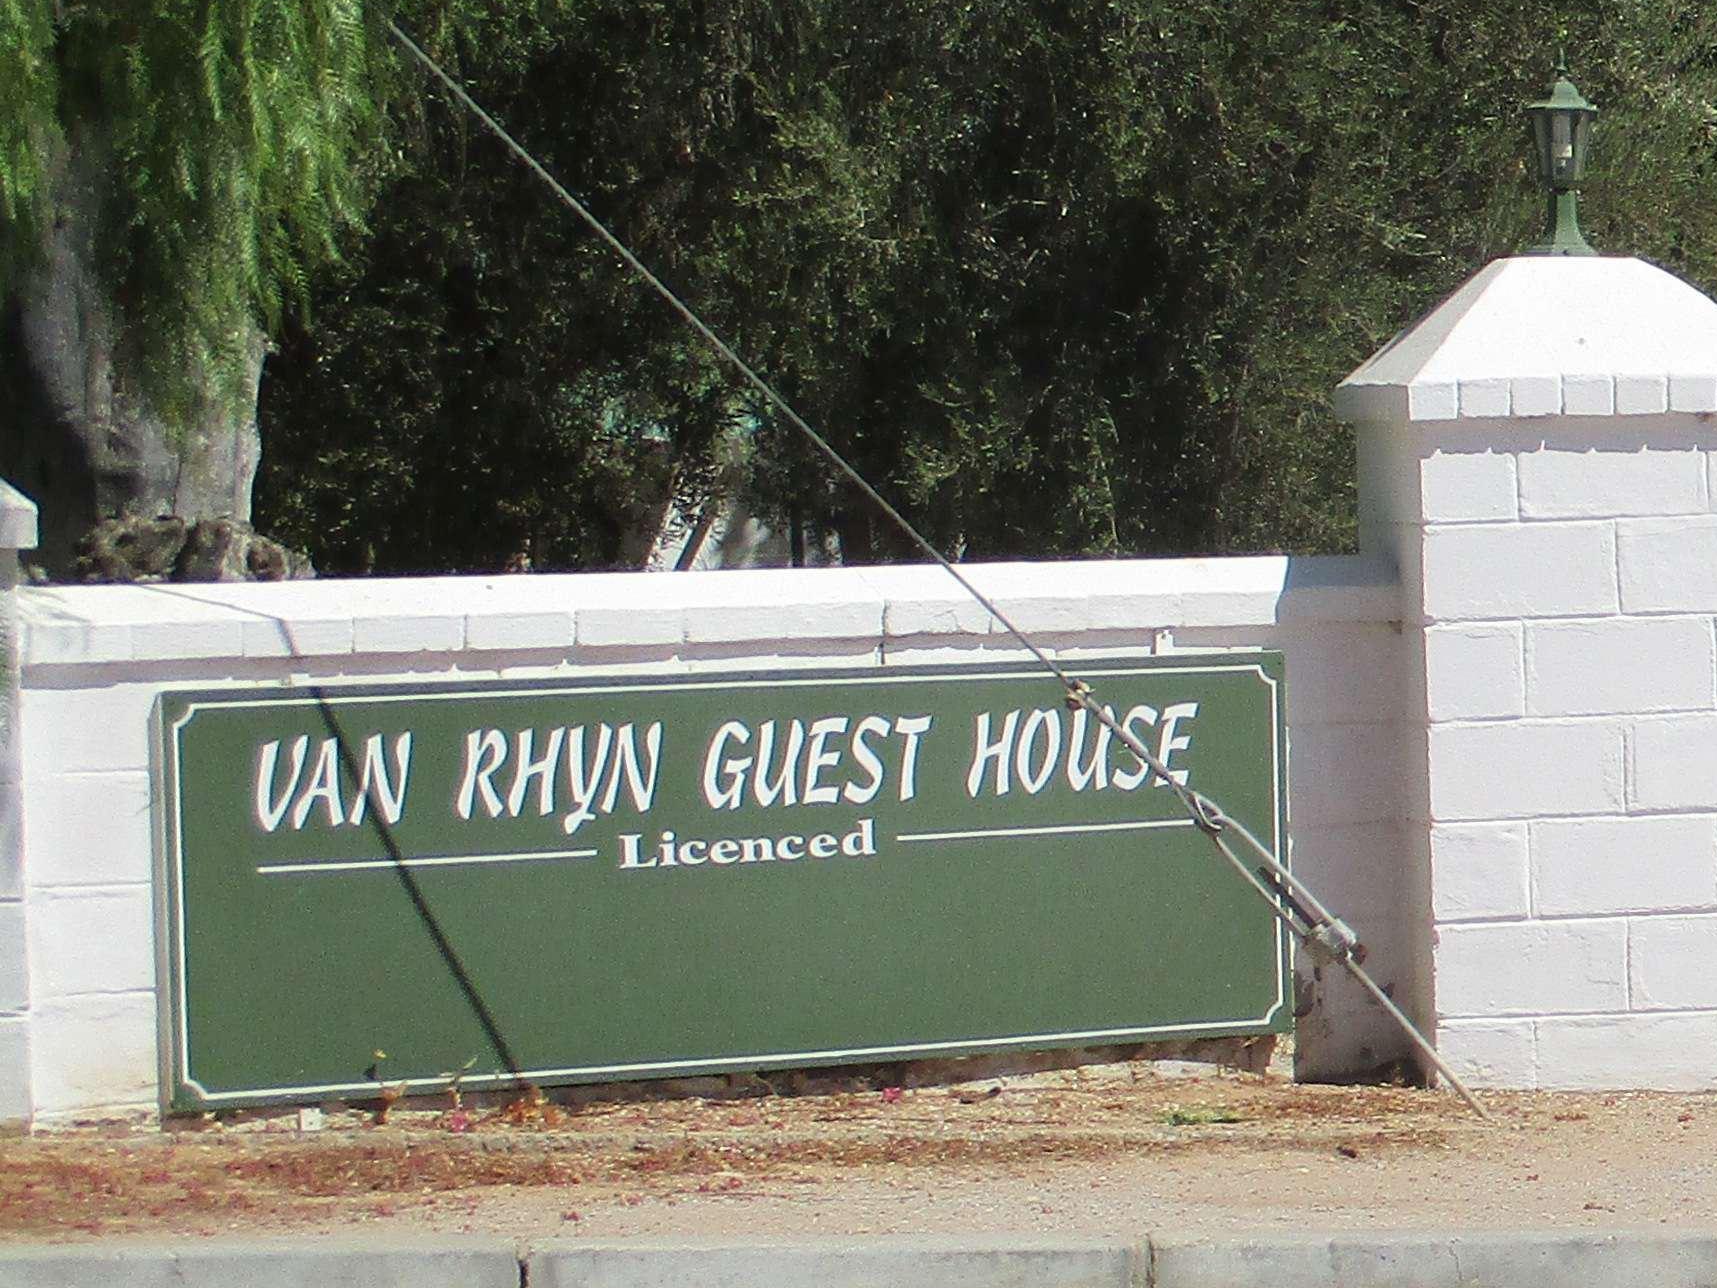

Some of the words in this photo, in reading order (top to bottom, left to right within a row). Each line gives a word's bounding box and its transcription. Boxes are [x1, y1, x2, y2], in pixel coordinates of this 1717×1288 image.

[255, 731, 413, 833] VAN
[456, 720, 662, 831] RHYN
[703, 715, 933, 811] GUEST
[966, 702, 1199, 798] HOUSE
[618, 818, 877, 871] Licenced
